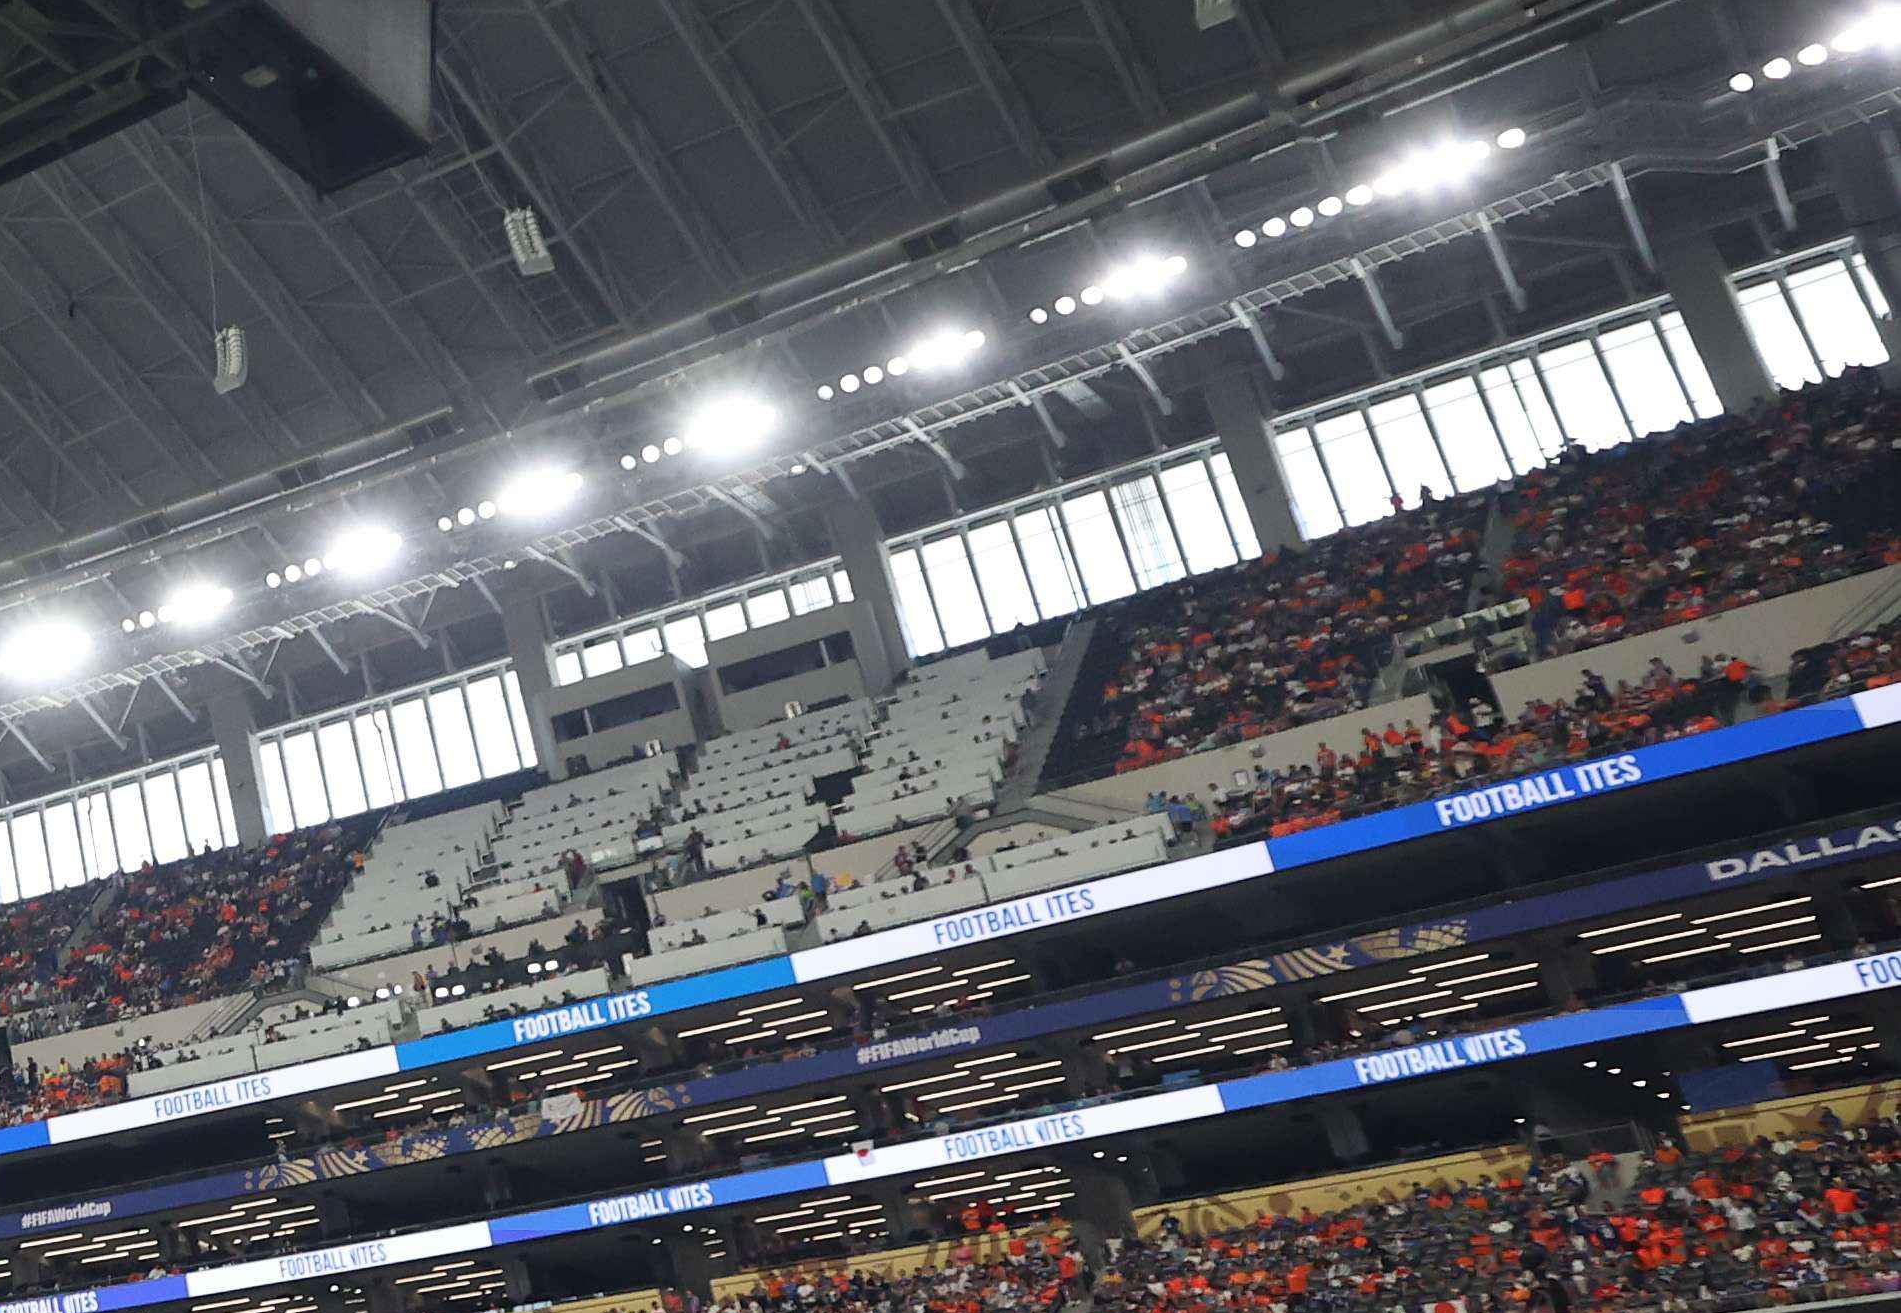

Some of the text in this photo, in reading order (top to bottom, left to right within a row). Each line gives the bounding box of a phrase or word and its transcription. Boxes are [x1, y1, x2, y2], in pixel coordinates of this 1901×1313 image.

[1438, 772, 1576, 825] FOOTBALL
[1706, 820, 1901, 881] DALLA
[933, 903, 1039, 946] FOOTBALL
[514, 1002, 606, 1041] FOOTBALL
[857, 1026, 981, 1064] #FIFAWorldCup
[1353, 1039, 1466, 1084] FOOTBALL
[154, 1084, 232, 1117] FOOTBALL
[944, 1126, 1036, 1160] FOOTBALL
[21, 1201, 112, 1228] #FIFAWorldCup
[587, 1188, 670, 1226] FOOTBALL
[279, 1251, 347, 1278] FOOTBALL
